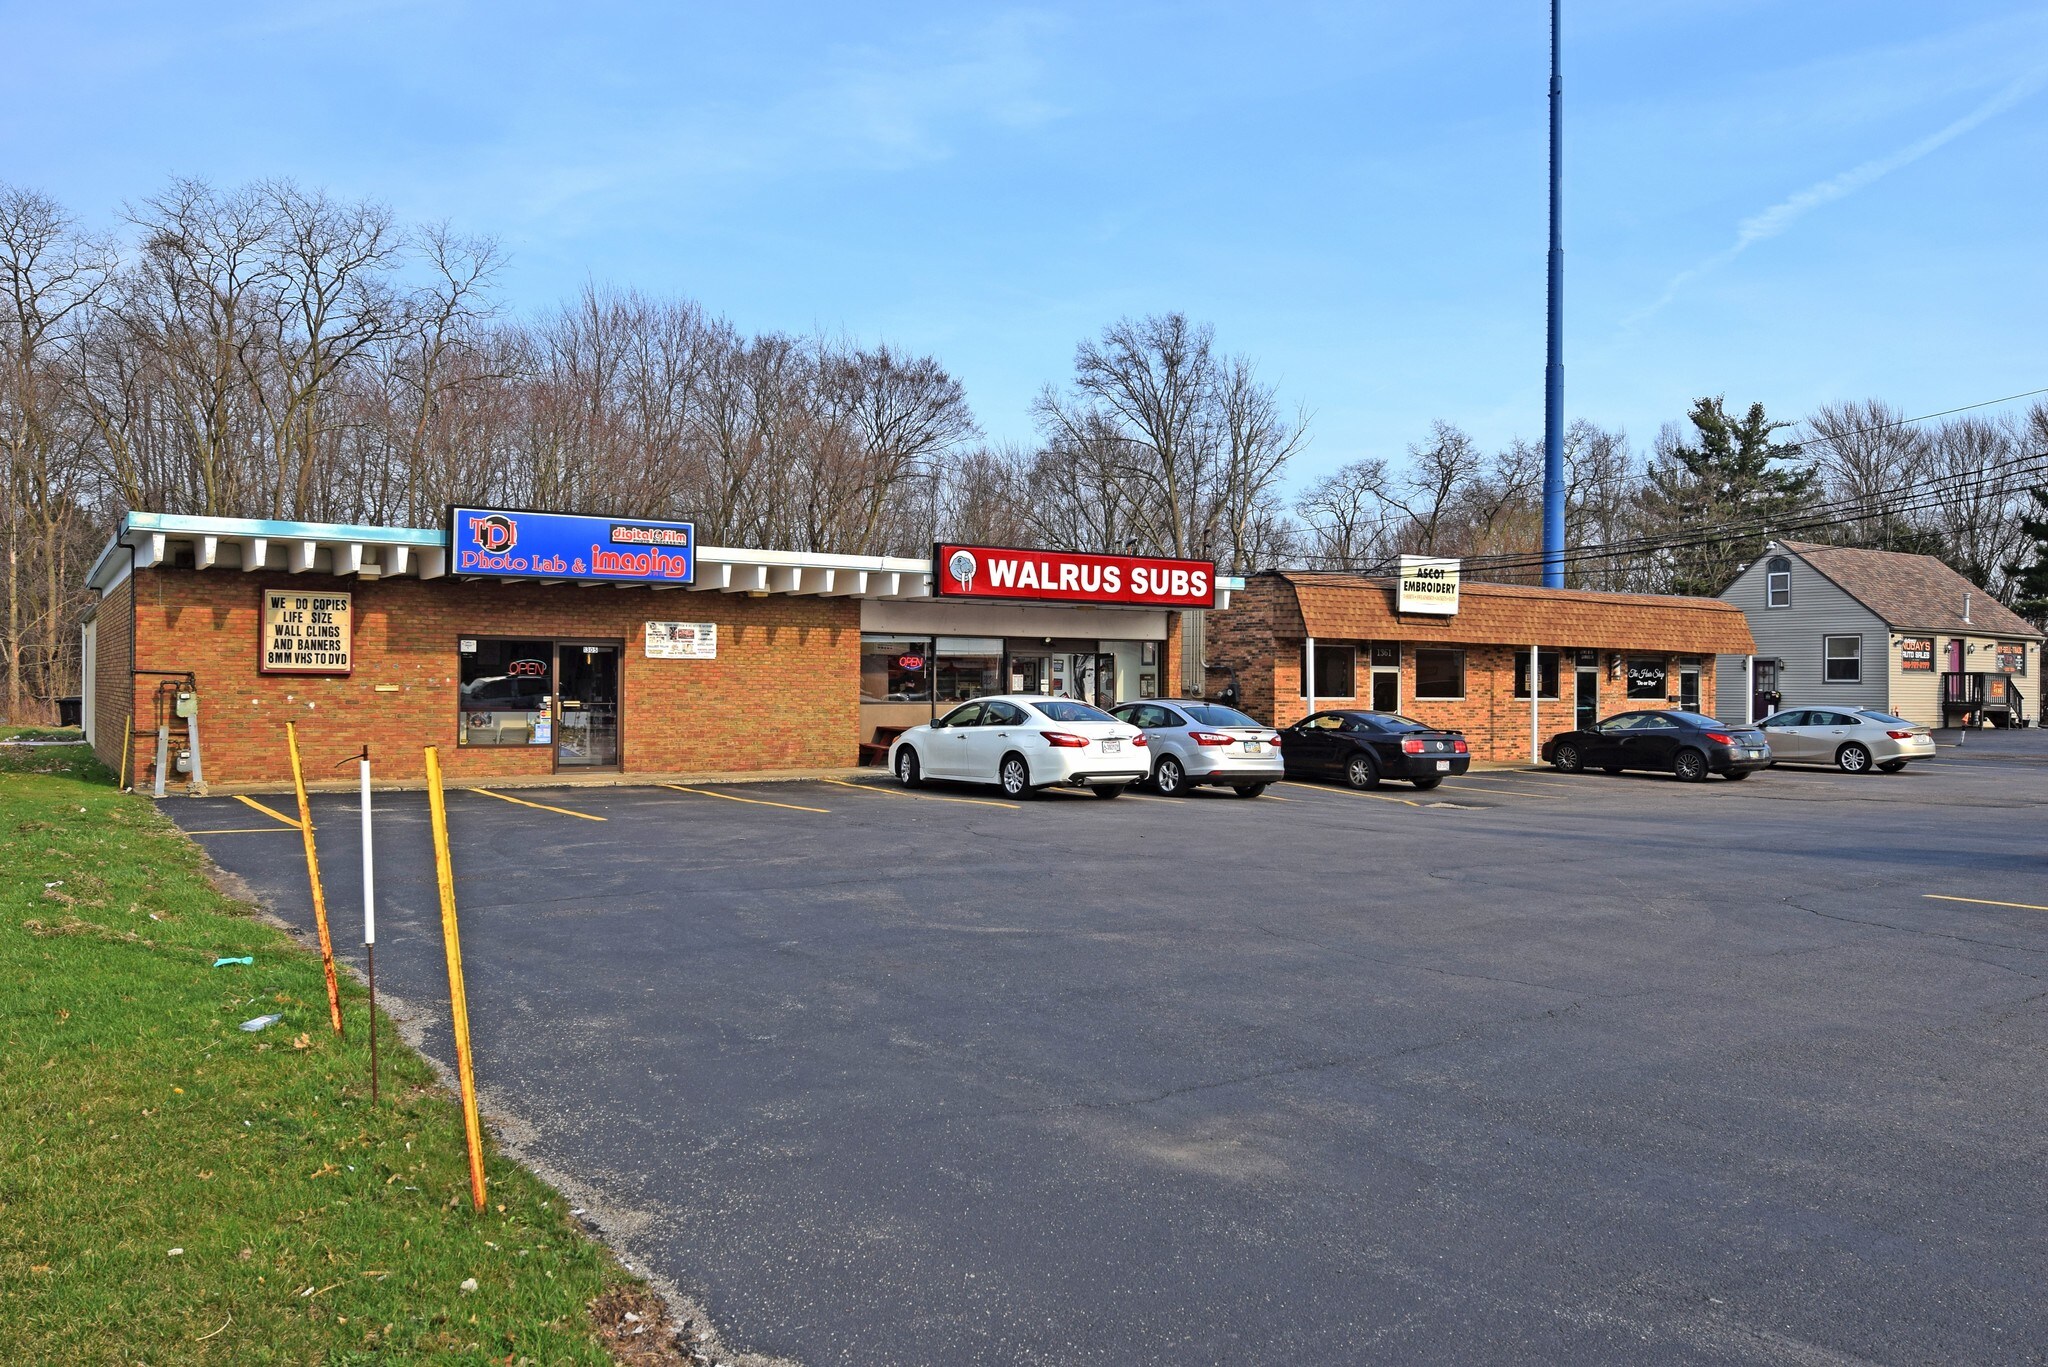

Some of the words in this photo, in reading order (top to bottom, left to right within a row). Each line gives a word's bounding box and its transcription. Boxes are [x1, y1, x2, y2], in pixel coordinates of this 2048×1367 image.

[612, 527, 653, 542] digital
[662, 530, 687, 542] film
[462, 551, 528, 570] Photo
[532, 554, 567, 573] Lab
[572, 558, 586, 573] &
[592, 544, 686, 578] imaging
[987, 559, 1121, 593] WALRUS
[1130, 567, 1207, 597] SUBS
[1417, 568, 1445, 579] ASCOT
[1403, 581, 1456, 594] EMBROIDERY
[271, 597, 286, 609] WE
[296, 598, 308, 610] DO
[313, 599, 347, 611] COPIES
[283, 611, 303, 623] LIFE
[311, 612, 333, 624] SIZE
[275, 625, 301, 637] WALL
[306, 626, 340, 637] CLINGS
[273, 639, 293, 650] AND
[297, 640, 341, 651] BANNERS
[268, 652, 292, 663] 8MM
[294, 653, 313, 664] VHS
[315, 653, 326, 664] TO
[328, 654, 347, 665] DVD
[899, 656, 923, 667] OPEN
[509, 662, 545, 675] OPEN
